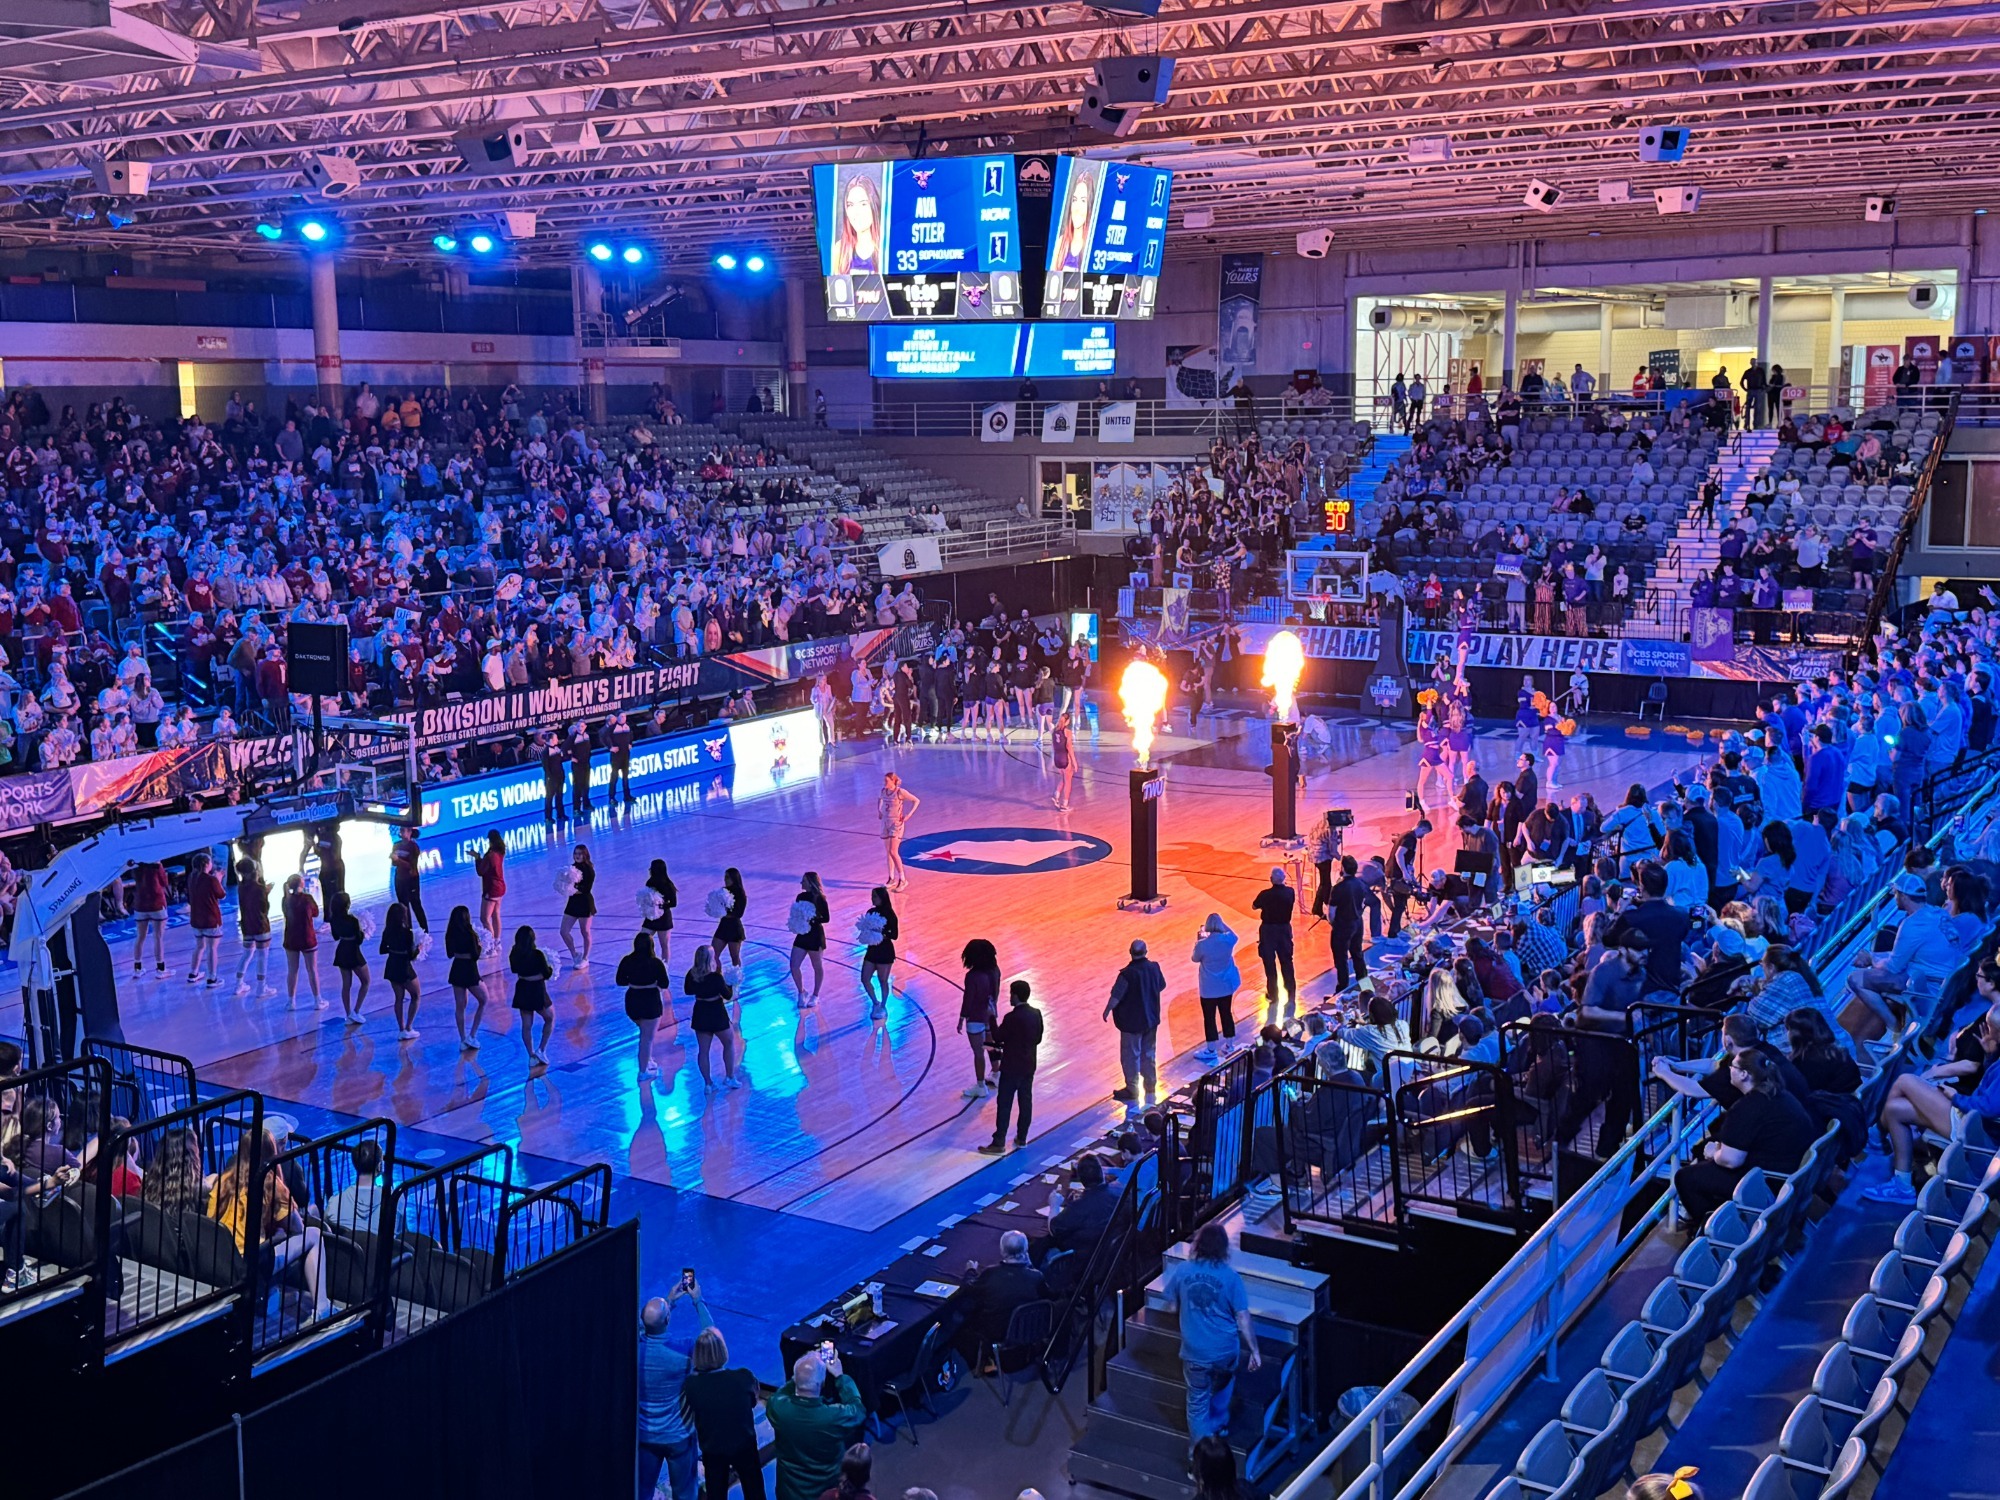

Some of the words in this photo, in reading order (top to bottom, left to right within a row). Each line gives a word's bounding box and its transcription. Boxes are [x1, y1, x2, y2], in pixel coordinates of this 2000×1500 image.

[915, 197, 937, 218] AVA
[911, 222, 945, 244] STIER
[897, 250, 918, 271] 33
[1092, 249, 1107, 270] 33
[1225, 269, 1259, 284] YOURS
[1786, 389, 1803, 397] 102
[1105, 416, 1131, 425] UNITED
[1325, 501, 1350, 513] 10:00
[1326, 512, 1346, 531] 30
[1783, 602, 1812, 610] NATION
[295, 653, 331, 661] DAKTRONICS
[1465, 633, 1534, 667] PLAY
[1539, 638, 1619, 671] HERE
[1634, 650, 1650, 659] CBS
[1651, 651, 1686, 661] SPORTS
[1633, 658, 1679, 669] NETWORK
[1787, 663, 1830, 680] YOURS
[423, 695, 506, 736] DIVISION
[511, 693, 524, 719] II
[614, 671, 655, 700] ELITE
[427, 732, 457, 746] WESTERN
[458, 729, 477, 740] STATE
[478, 722, 514, 736] UNIVERSITY
[514, 718, 528, 729] AND
[539, 711, 562, 723] JOSEPH
[562, 707, 585, 719] SPORTS
[585, 700, 622, 715] COMMISSION
[664, 744, 699, 770] STATE
[0, 781, 54, 803] PORTS
[1142, 776, 1166, 803] TWU
[278, 812, 299, 824] MAKE
[306, 802, 339, 822] YOURS
[451, 789, 499, 818] TEXAS
[48, 877, 83, 915] SPALDING
